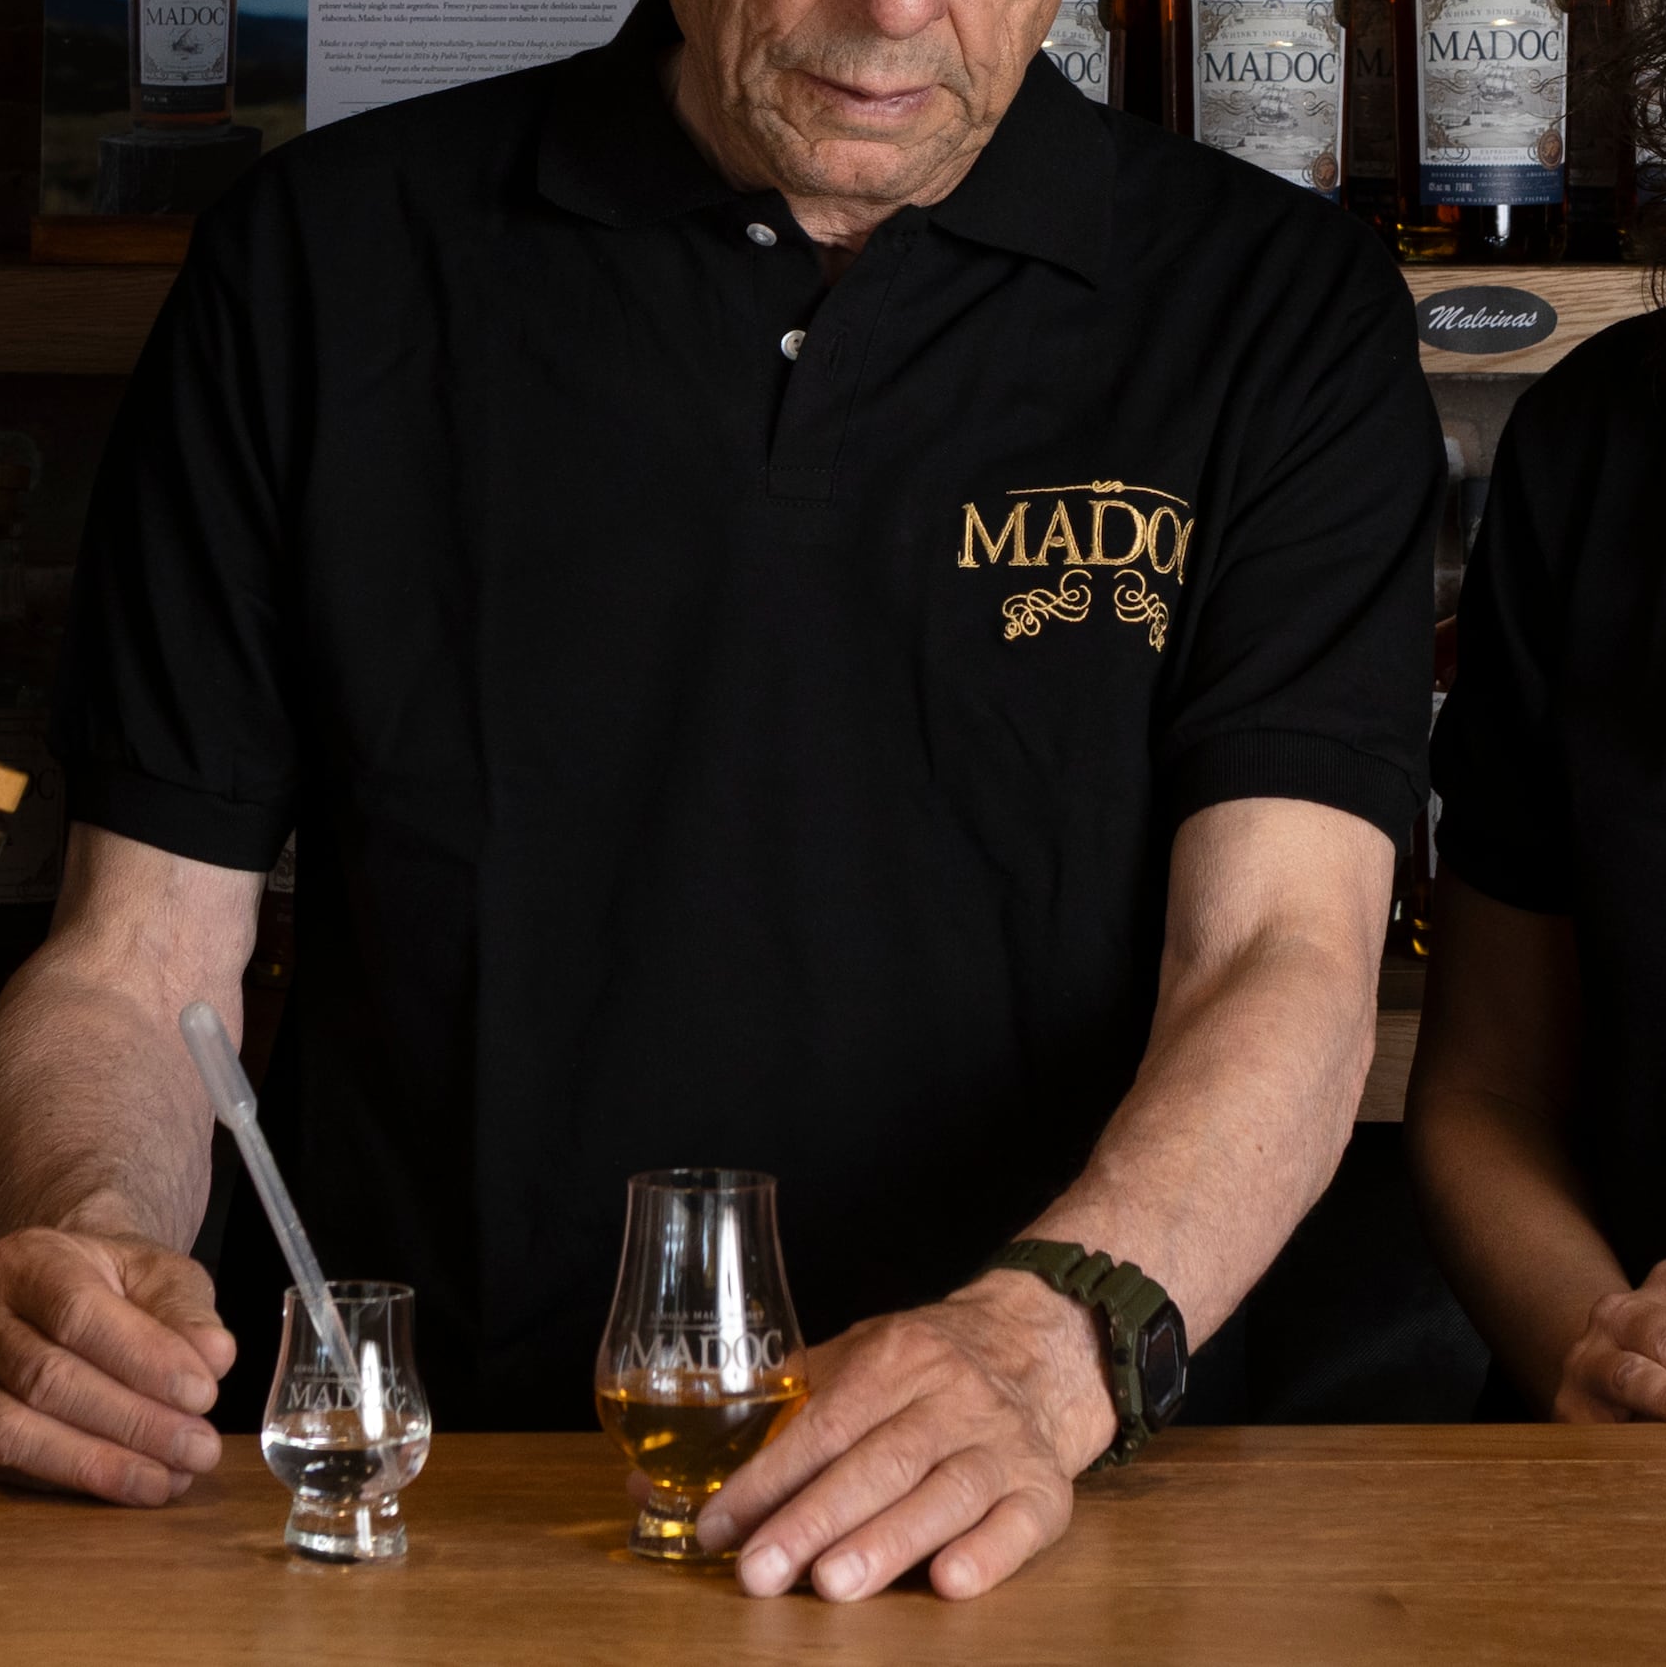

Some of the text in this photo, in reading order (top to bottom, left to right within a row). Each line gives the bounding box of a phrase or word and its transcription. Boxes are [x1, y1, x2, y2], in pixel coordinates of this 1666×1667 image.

[146, 7, 225, 26] MADOC
[1444, 9, 1482, 18] WHISKY
[1486, 8, 1520, 16] SINGLE
[1221, 31, 1257, 39] WHISKY
[1428, 29, 1559, 62] MADOC
[1204, 51, 1336, 83] MADOC
[1428, 305, 1538, 330] Malvinas
[629, 1330, 785, 1374] MADOC
[287, 1383, 406, 1411] MADC
